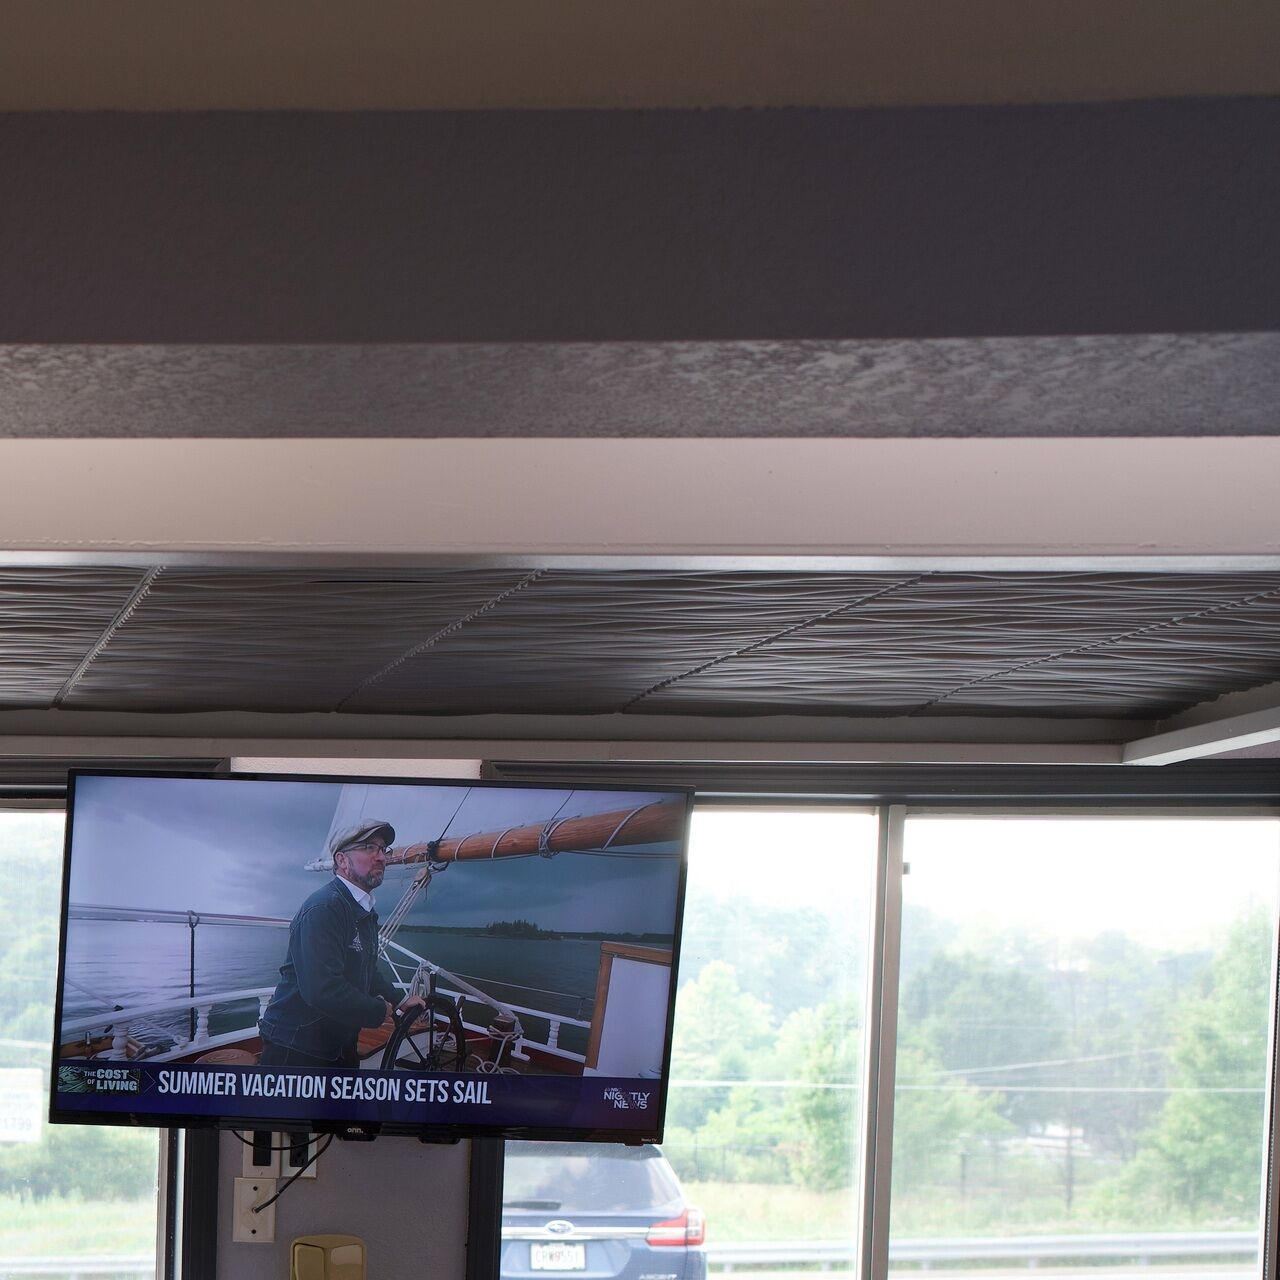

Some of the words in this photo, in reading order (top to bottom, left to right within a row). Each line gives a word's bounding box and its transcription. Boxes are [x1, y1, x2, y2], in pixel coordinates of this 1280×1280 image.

[96, 1068, 130, 1080] COST
[96, 1080, 138, 1091] LIVING
[158, 1070, 236, 1096] SUMMER
[242, 1073, 326, 1099] VACATION
[330, 1076, 400, 1101] SEASON
[404, 1078, 449, 1103] SETS
[452, 1080, 492, 1104] SAIL
[604, 1092, 650, 1101] NIGTLY
